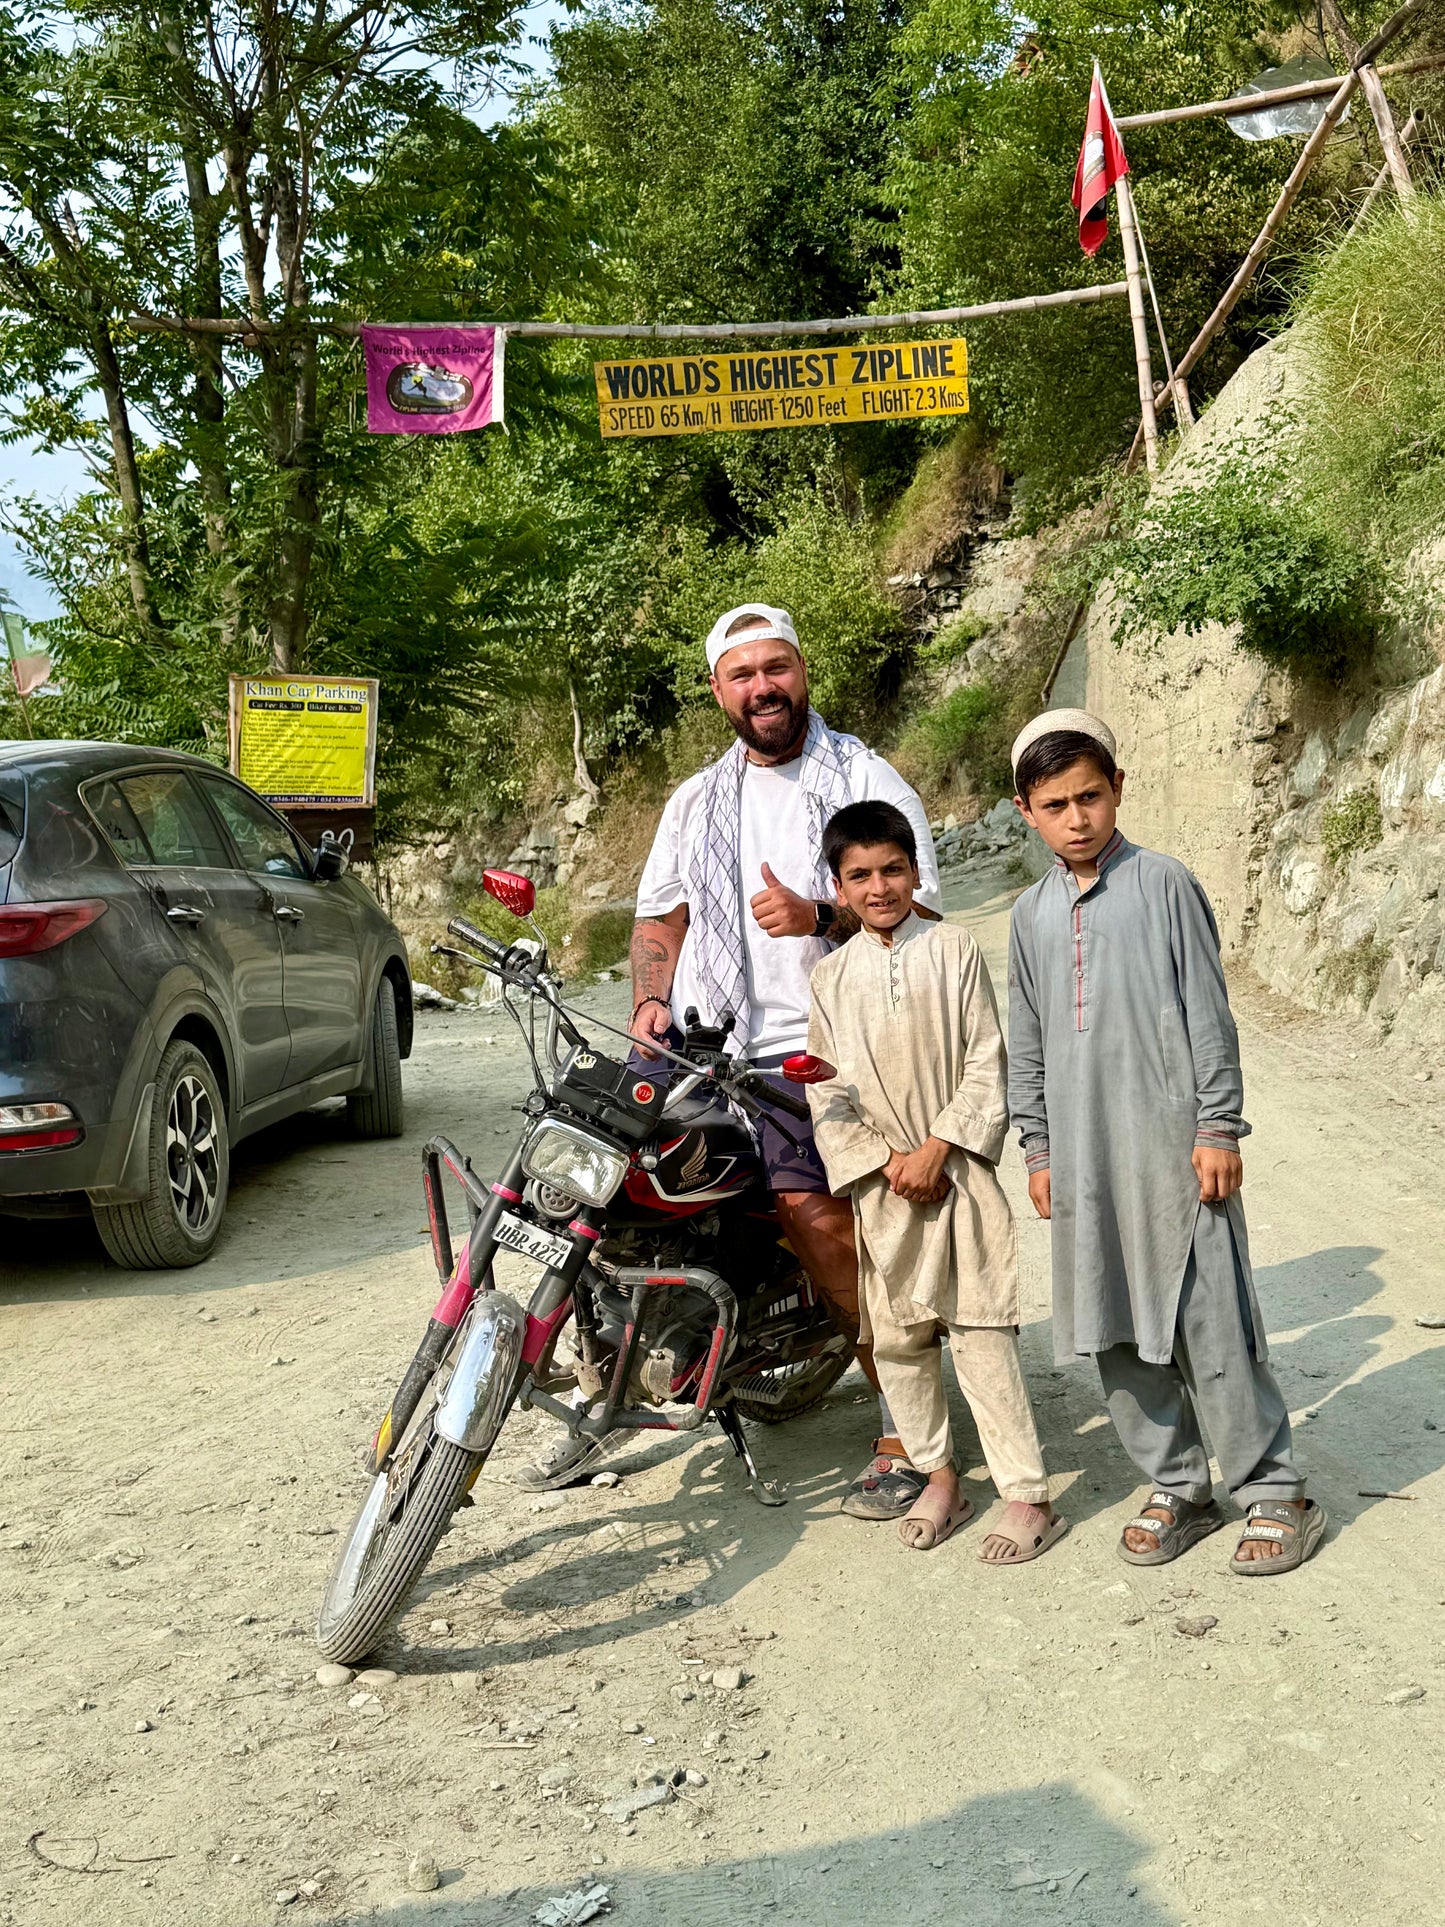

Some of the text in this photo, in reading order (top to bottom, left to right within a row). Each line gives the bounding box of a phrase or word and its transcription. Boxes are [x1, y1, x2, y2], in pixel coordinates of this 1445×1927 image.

[412, 345, 451, 358] Highest
[452, 344, 486, 356] Zipline
[604, 345, 955, 400] WORLD'S HIGHEST ZIPLINE
[609, 406, 654, 431] SPEED
[661, 405, 679, 428] 65
[683, 402, 721, 427] Km/H
[818, 395, 848, 418] Feet
[939, 385, 965, 409] Kms
[246, 682, 367, 702] Khan Car Parking
[309, 703, 323, 711] Bike
[638, 1088, 651, 1098] VIP
[495, 1224, 566, 1267] HBR 4271
[1243, 1526, 1283, 1538] SUMMER
